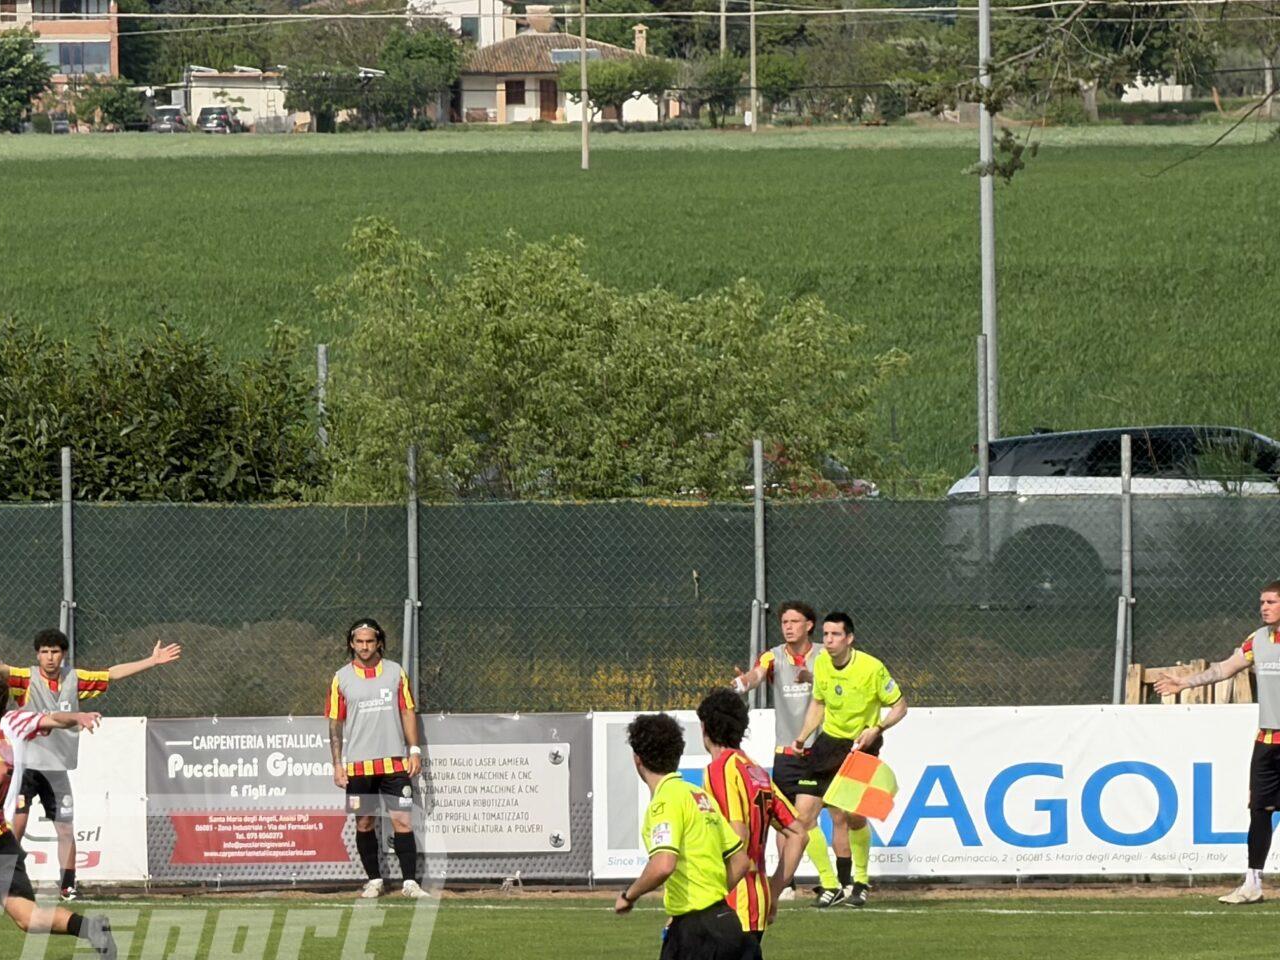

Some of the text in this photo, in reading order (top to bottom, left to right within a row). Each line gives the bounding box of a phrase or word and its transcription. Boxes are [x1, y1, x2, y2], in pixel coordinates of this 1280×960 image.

[192, 734, 323, 750] CARPENTERIA METALLICA
[168, 753, 259, 779] Pucciarini
[420, 757, 529, 767] CENTRO TAGLIO LASER LAMIERA
[457, 771, 471, 780] CON
[473, 771, 509, 780] MACCHINE
[511, 771, 516, 779] A
[518, 771, 532, 779] CNC
[230, 786, 239, 797] &
[464, 785, 478, 793] CON
[480, 785, 516, 793] MACCHINE
[518, 785, 523, 793] A
[525, 784, 539, 793] CNC
[430, 798, 519, 807] SALDATURA ROBOTIZZATA
[817, 761, 1280, 848] AGOL
[208, 815, 226, 824] Santa
[227, 815, 243, 823] Maria
[243, 815, 257, 824] degli
[445, 812, 471, 821] PROFILI
[218, 824, 232, 832] Zona
[233, 823, 263, 832] Industriale
[267, 823, 277, 831] Via
[507, 825, 512, 833] A
[515, 825, 544, 833] POLVERI
[77, 824, 102, 842] srl
[235, 832, 246, 840] Tel.
[607, 856, 634, 867] Since
[907, 854, 922, 863] Via
[924, 854, 940, 863] del
[942, 853, 1000, 864] Caminaccio,
[1002, 853, 1008, 862] 2
[1016, 853, 1043, 862] 06081
[1055, 852, 1083, 861] Maria
[1086, 852, 1110, 864] degli
[1111, 852, 1142, 863] Angeli
[1150, 851, 1176, 861] Assisi
[1178, 852, 1199, 863] (PG)
[1206, 851, 1228, 862] Italy
